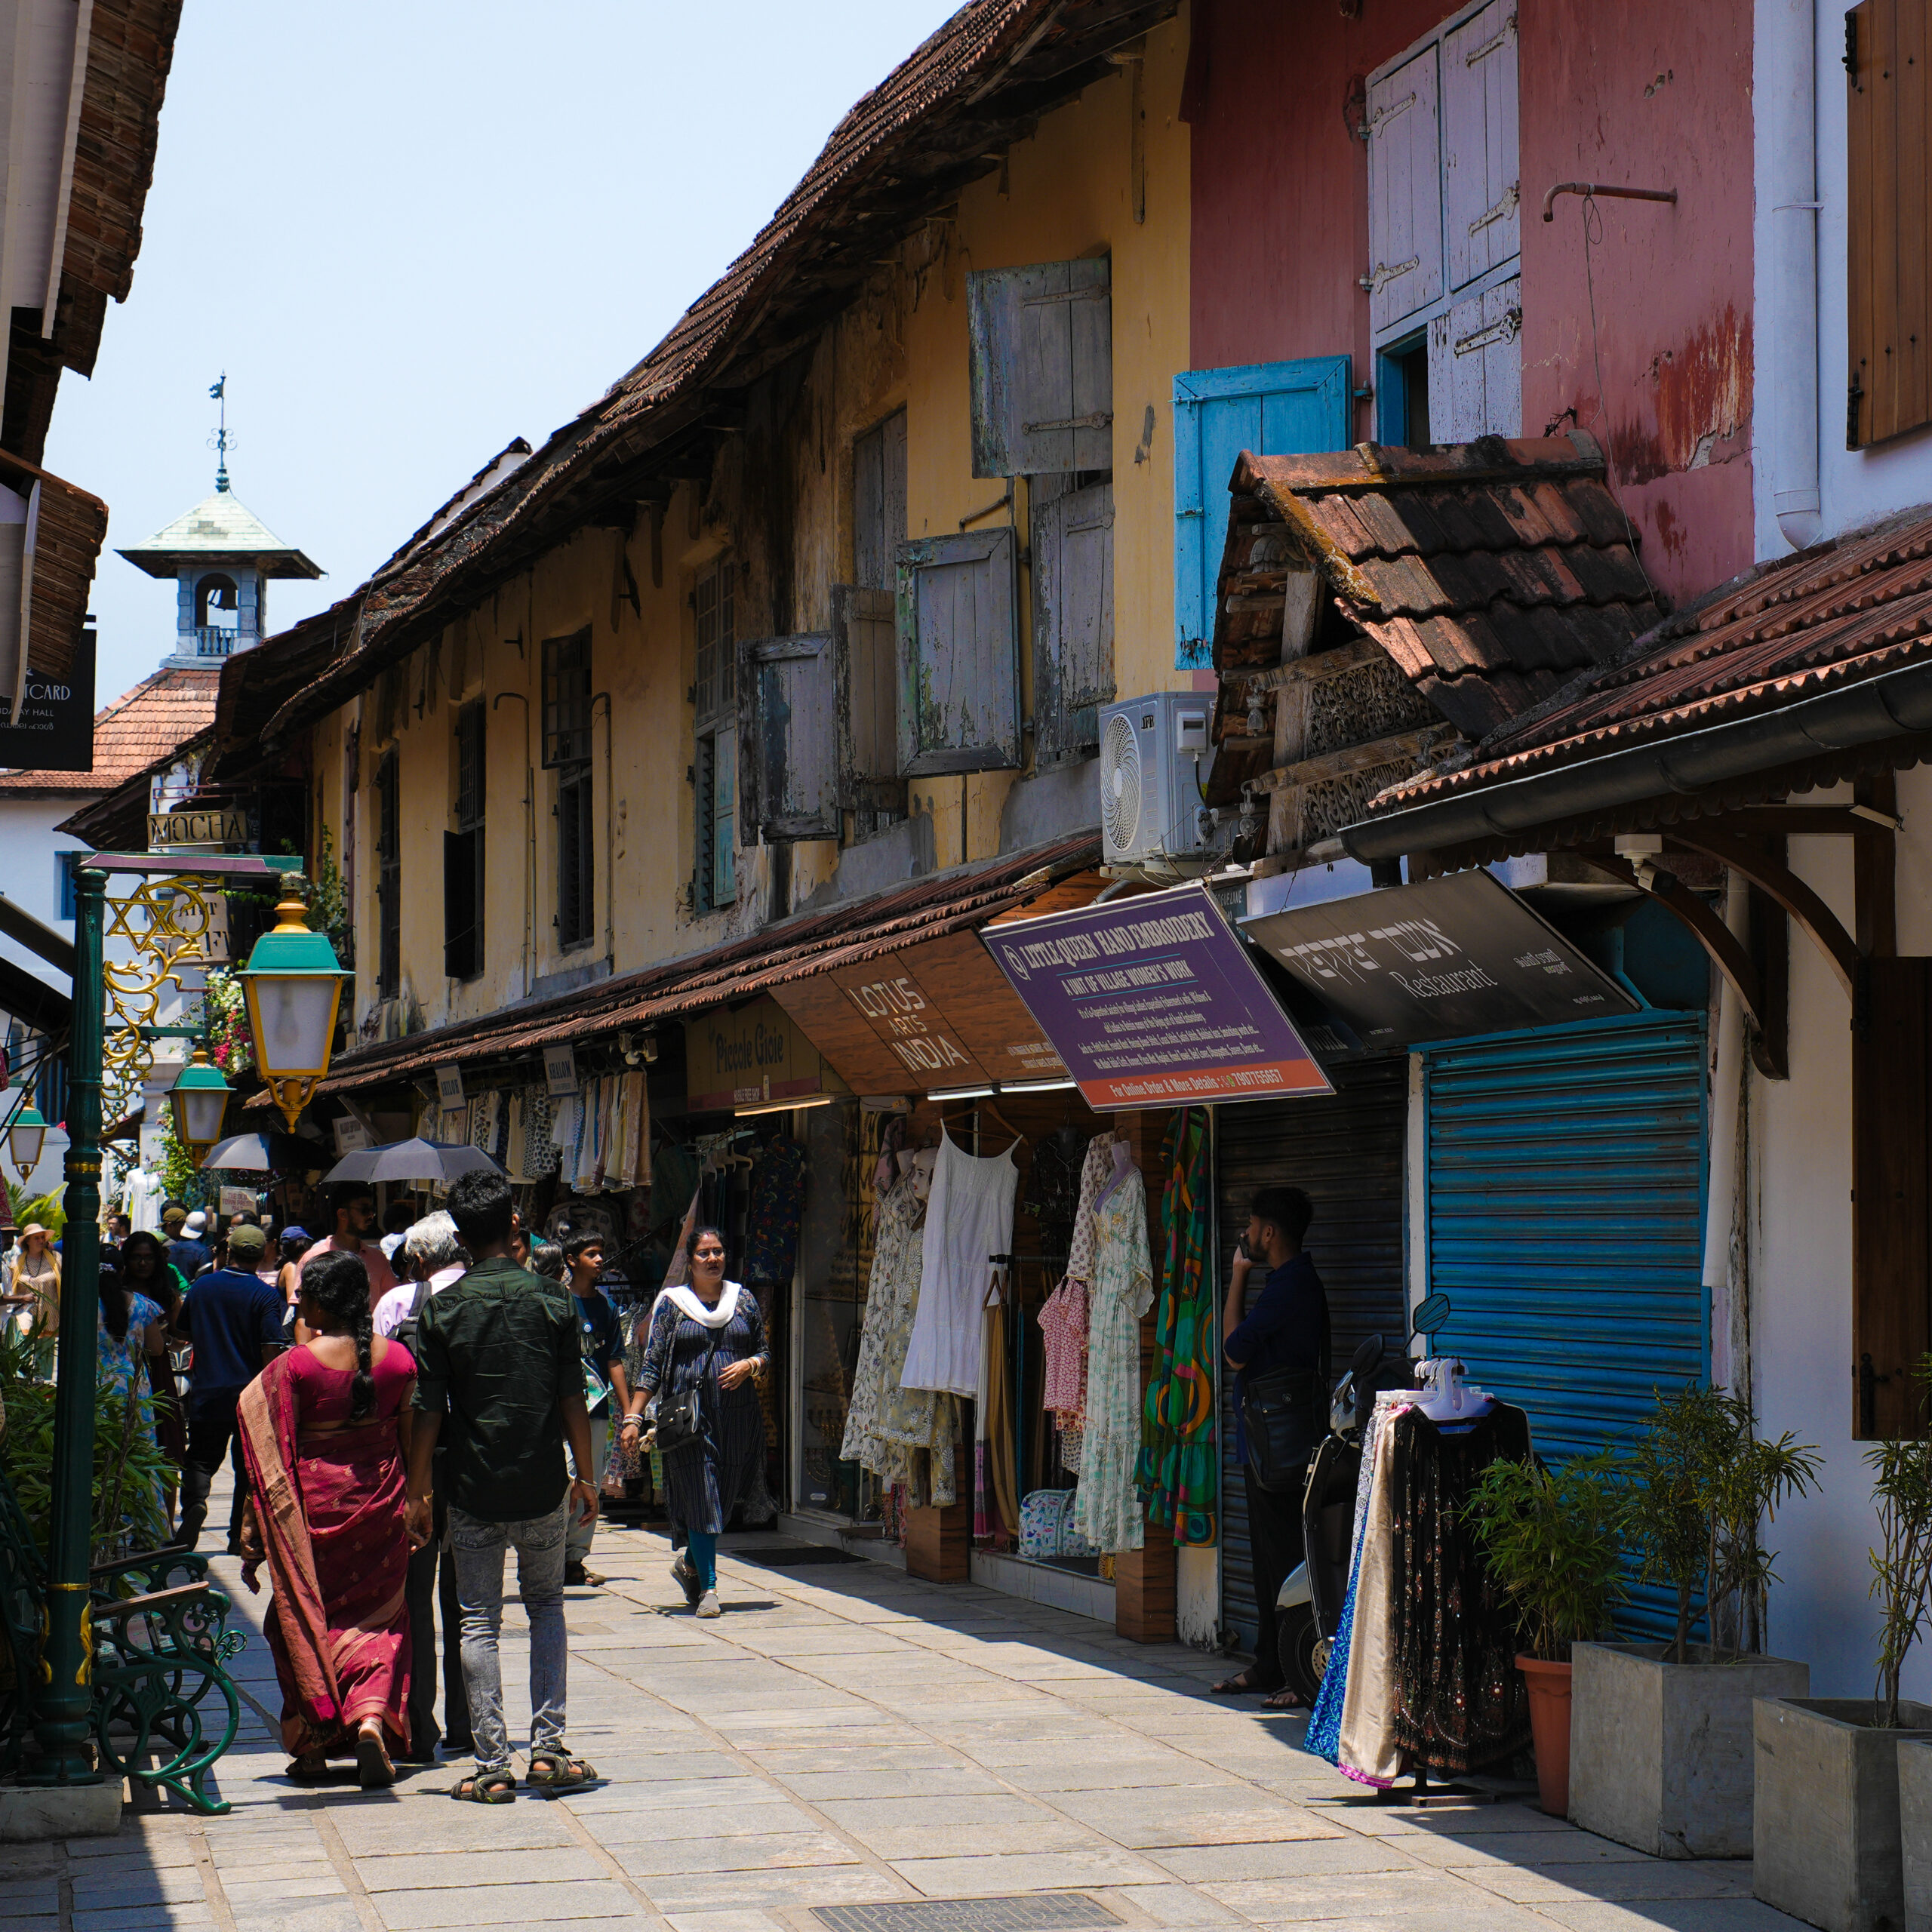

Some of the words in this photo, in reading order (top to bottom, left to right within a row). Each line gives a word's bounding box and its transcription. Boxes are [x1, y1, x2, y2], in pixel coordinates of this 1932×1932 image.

[32, 709, 55, 717] HALL
[150, 814, 244, 843] MOCHA
[178, 902, 217, 917] AT
[1018, 940, 1064, 969] LITTLE
[1054, 933, 1101, 968] QUEEN
[1093, 925, 1137, 955] HAND
[1126, 910, 1215, 949] EMBROIDERY
[1094, 970, 1131, 990] VILLAGE
[1124, 963, 1168, 986] WOMEN'S
[1161, 959, 1195, 980] WORK
[1389, 959, 1498, 999] Restaurant
[1060, 980, 1073, 995] A
[1066, 977, 1090, 995] UNIT
[1084, 974, 1100, 992] OF
[849, 977, 926, 1017] LOTUS
[888, 1014, 928, 1037] ARTS
[716, 1029, 752, 1074] Piccole
[755, 1023, 784, 1066] Gioie
[891, 1034, 969, 1072] INDIA
[549, 1060, 572, 1080] SHALOM
[1108, 1084, 1125, 1097] For
[1121, 1081, 1147, 1096] Online
[1142, 1080, 1166, 1094] Order
[1161, 1078, 1174, 1093] &
[1168, 1078, 1192, 1091] More
[1187, 1075, 1220, 1090] Details
[1232, 1069, 1284, 1086] 7907755657
